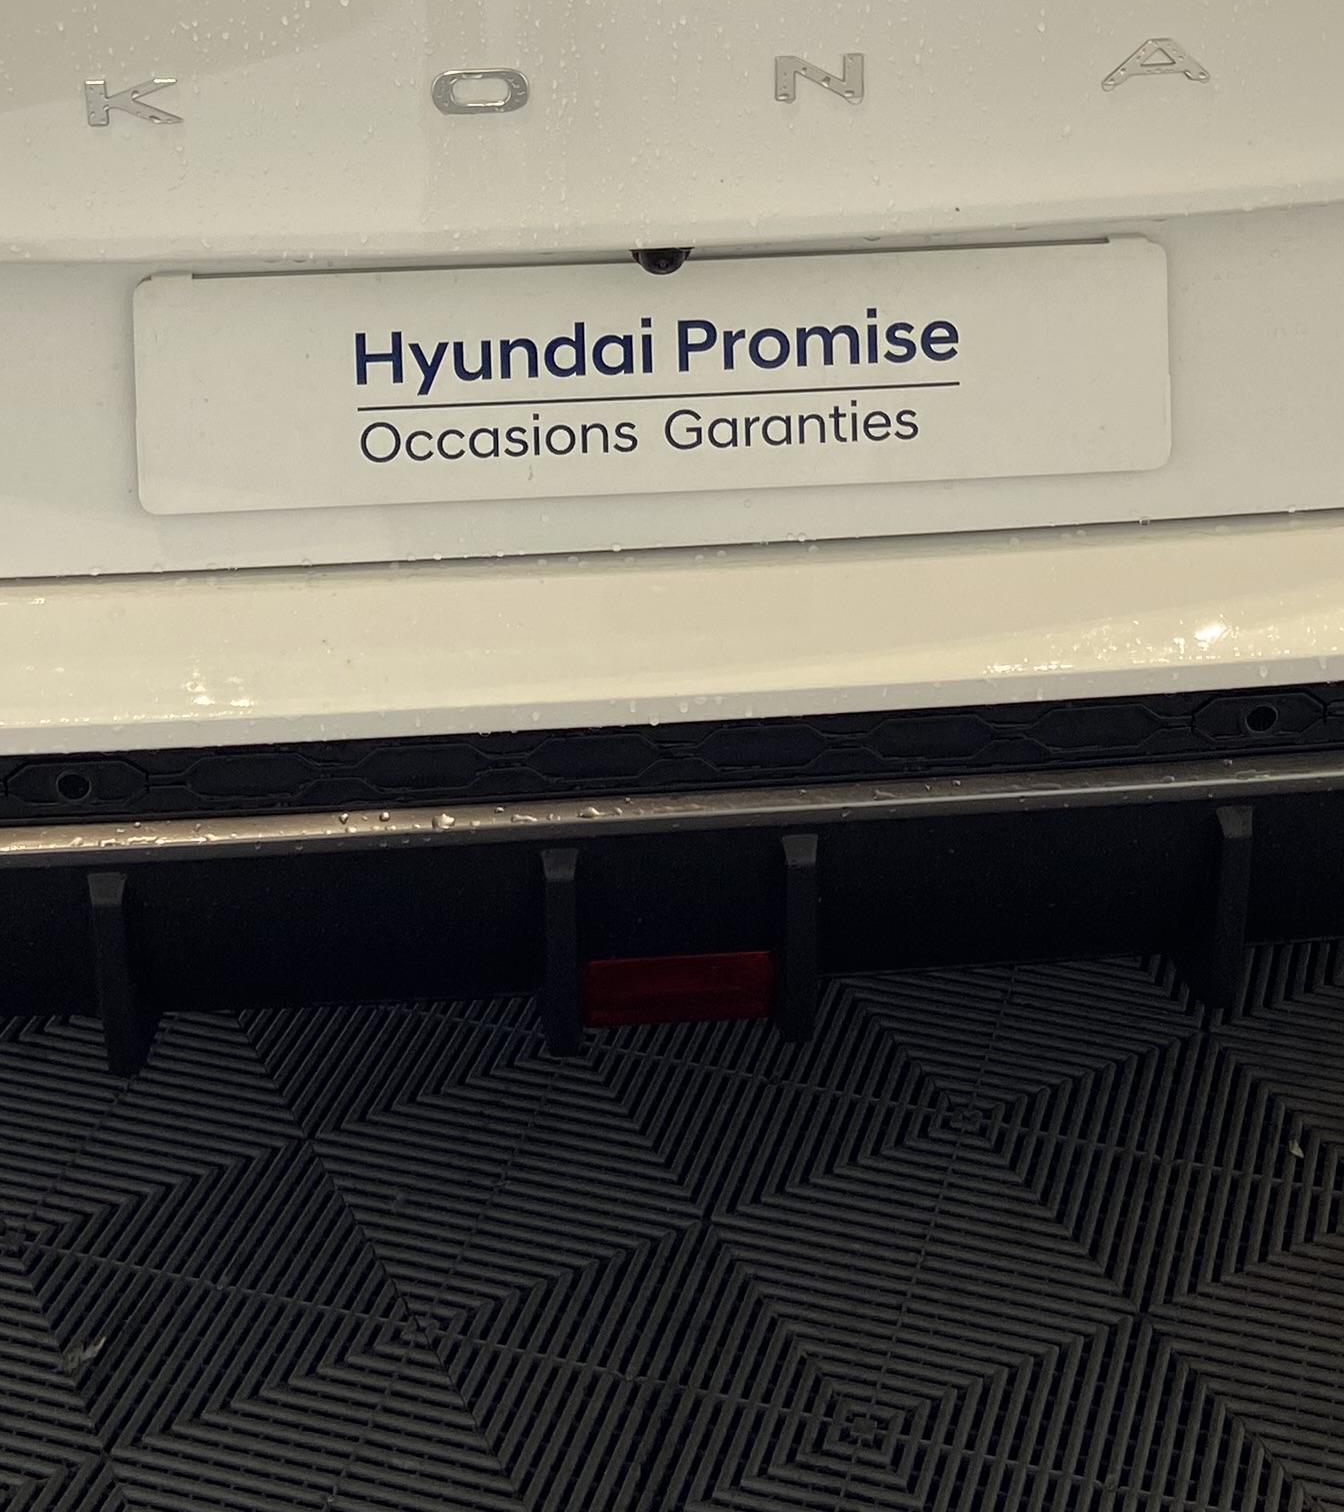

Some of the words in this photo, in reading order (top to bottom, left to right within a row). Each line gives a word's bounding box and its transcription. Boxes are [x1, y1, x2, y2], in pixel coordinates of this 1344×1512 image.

[355, 317, 653, 396] Hyundai
[677, 307, 959, 373] Promise
[360, 413, 638, 463] Occasions
[664, 399, 919, 450] Garanties
